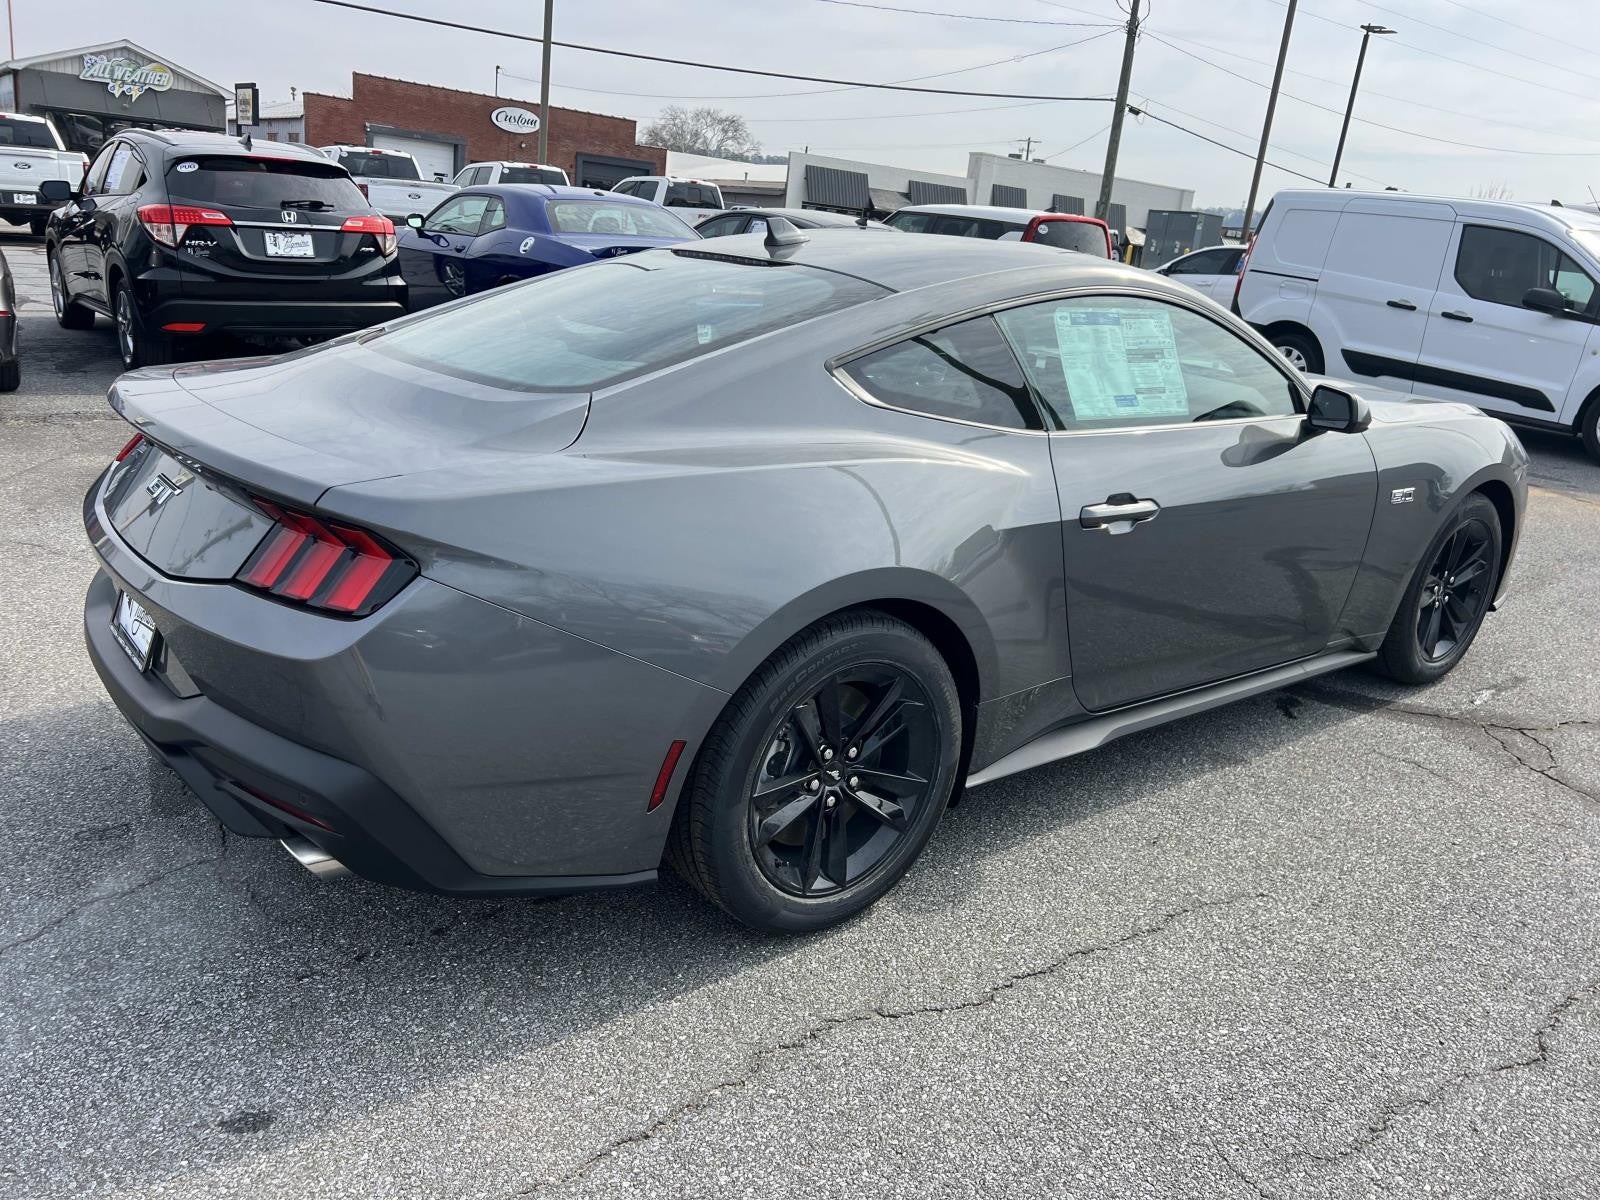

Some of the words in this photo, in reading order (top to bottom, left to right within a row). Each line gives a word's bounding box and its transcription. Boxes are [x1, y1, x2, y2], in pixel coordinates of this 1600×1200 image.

[86, 62, 111, 78] ALL
[113, 65, 169, 86] WEATHER
[495, 110, 538, 127] Custom
[146, 473, 183, 505] GT
[1391, 487, 1416, 504] 5.0
